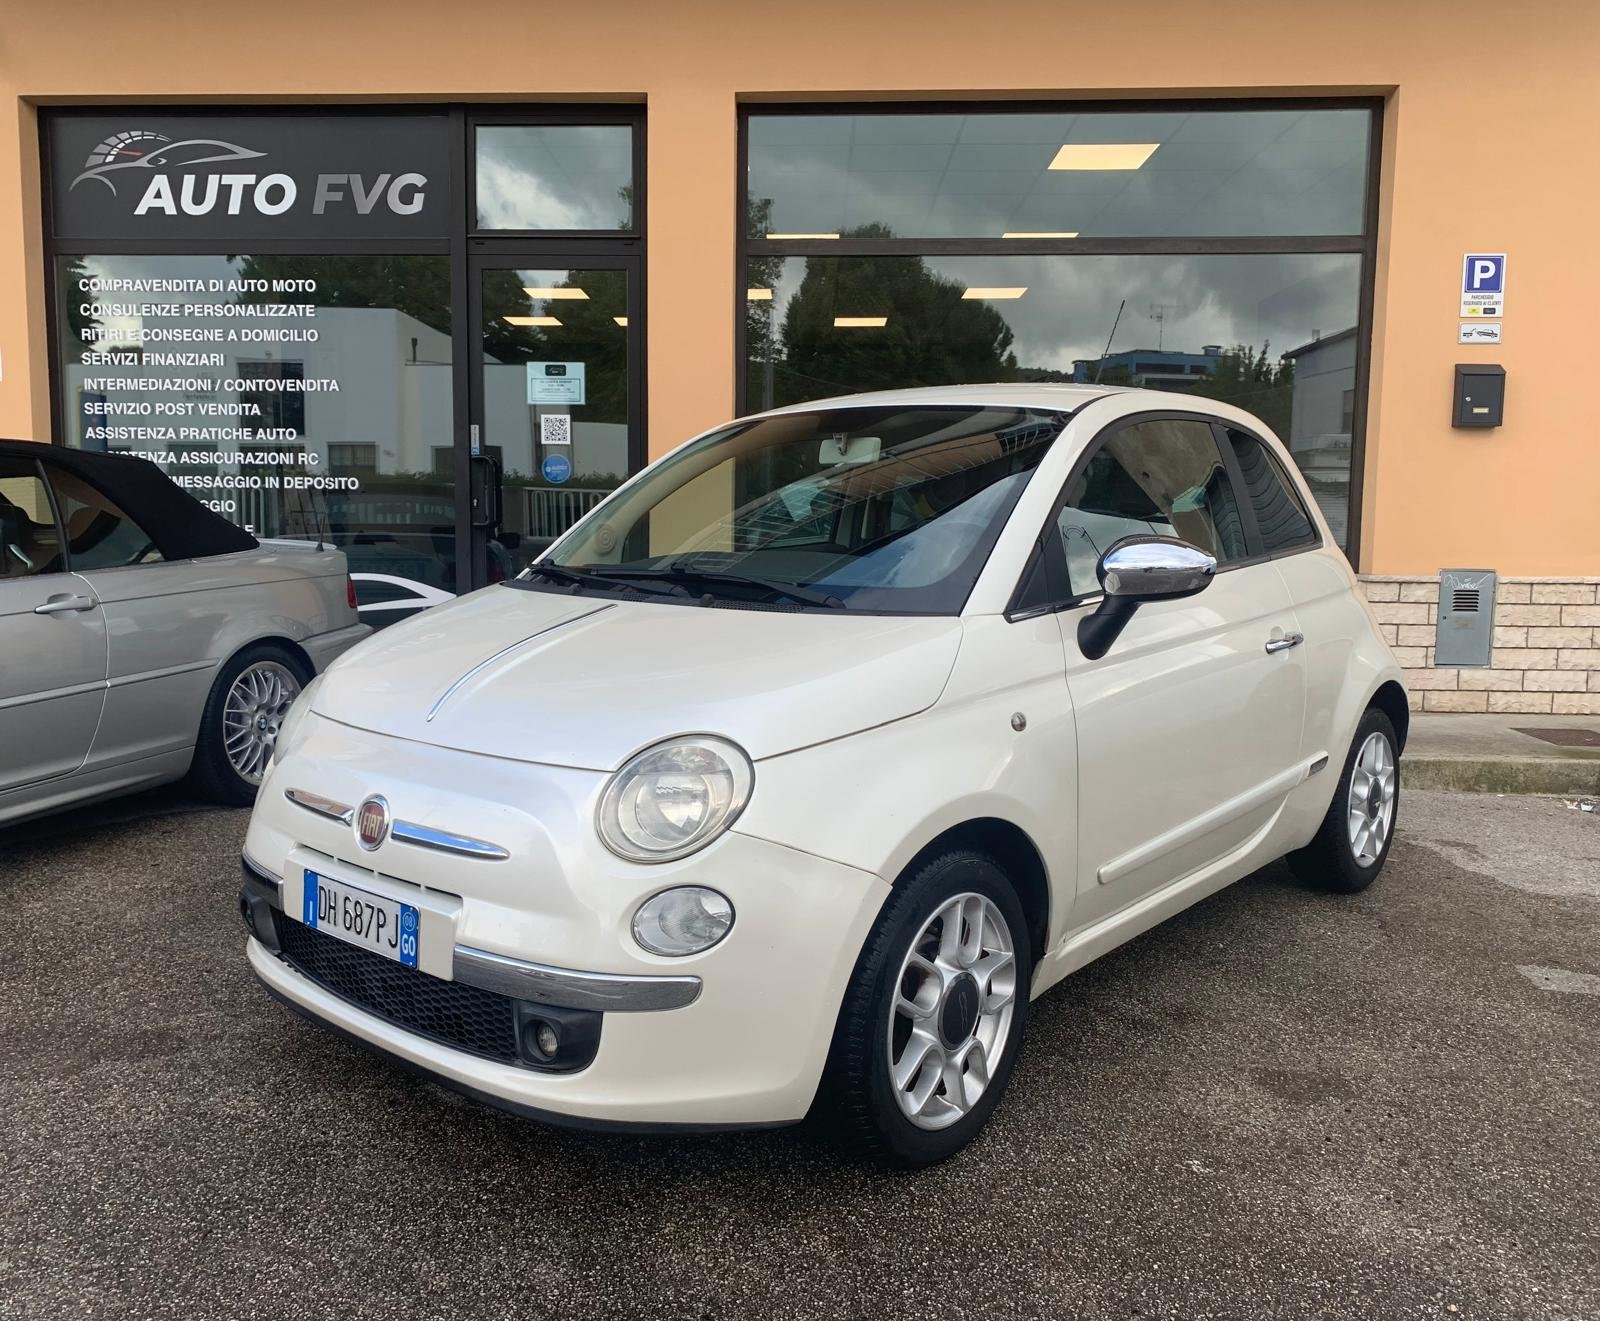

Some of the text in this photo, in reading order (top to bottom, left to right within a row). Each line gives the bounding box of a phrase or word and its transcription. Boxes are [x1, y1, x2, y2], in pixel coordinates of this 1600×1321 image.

[133, 172, 429, 216] AUTO FVG
[1473, 260, 1496, 289] P
[78, 278, 317, 293] COMPRAVENDITA DI AUTO MOTO
[79, 303, 316, 318] CONSULENZE PERSONALIZZATE
[80, 328, 319, 342] RITIRI E CONSEGNE A DOMICILIO
[81, 352, 224, 367] SERVIZI FINANZIARI
[84, 378, 211, 392] INTERMEDIAZIONI
[223, 379, 340, 392] CONTOVENDITA
[84, 402, 261, 416] SERVIZIO POST VENDITA
[85, 426, 297, 441] ASSISTENZA PRATICHE AUTO
[180, 451, 294, 465] ASSICURAZIONI
[298, 452, 319, 466] RC
[168, 475, 359, 490] MESSAGGIO IN DEPOSITO
[362, 812, 383, 838] FIAT
[318, 885, 337, 927] DH
[343, 895, 399, 949] 687PJ
[402, 933, 417, 957] GO
